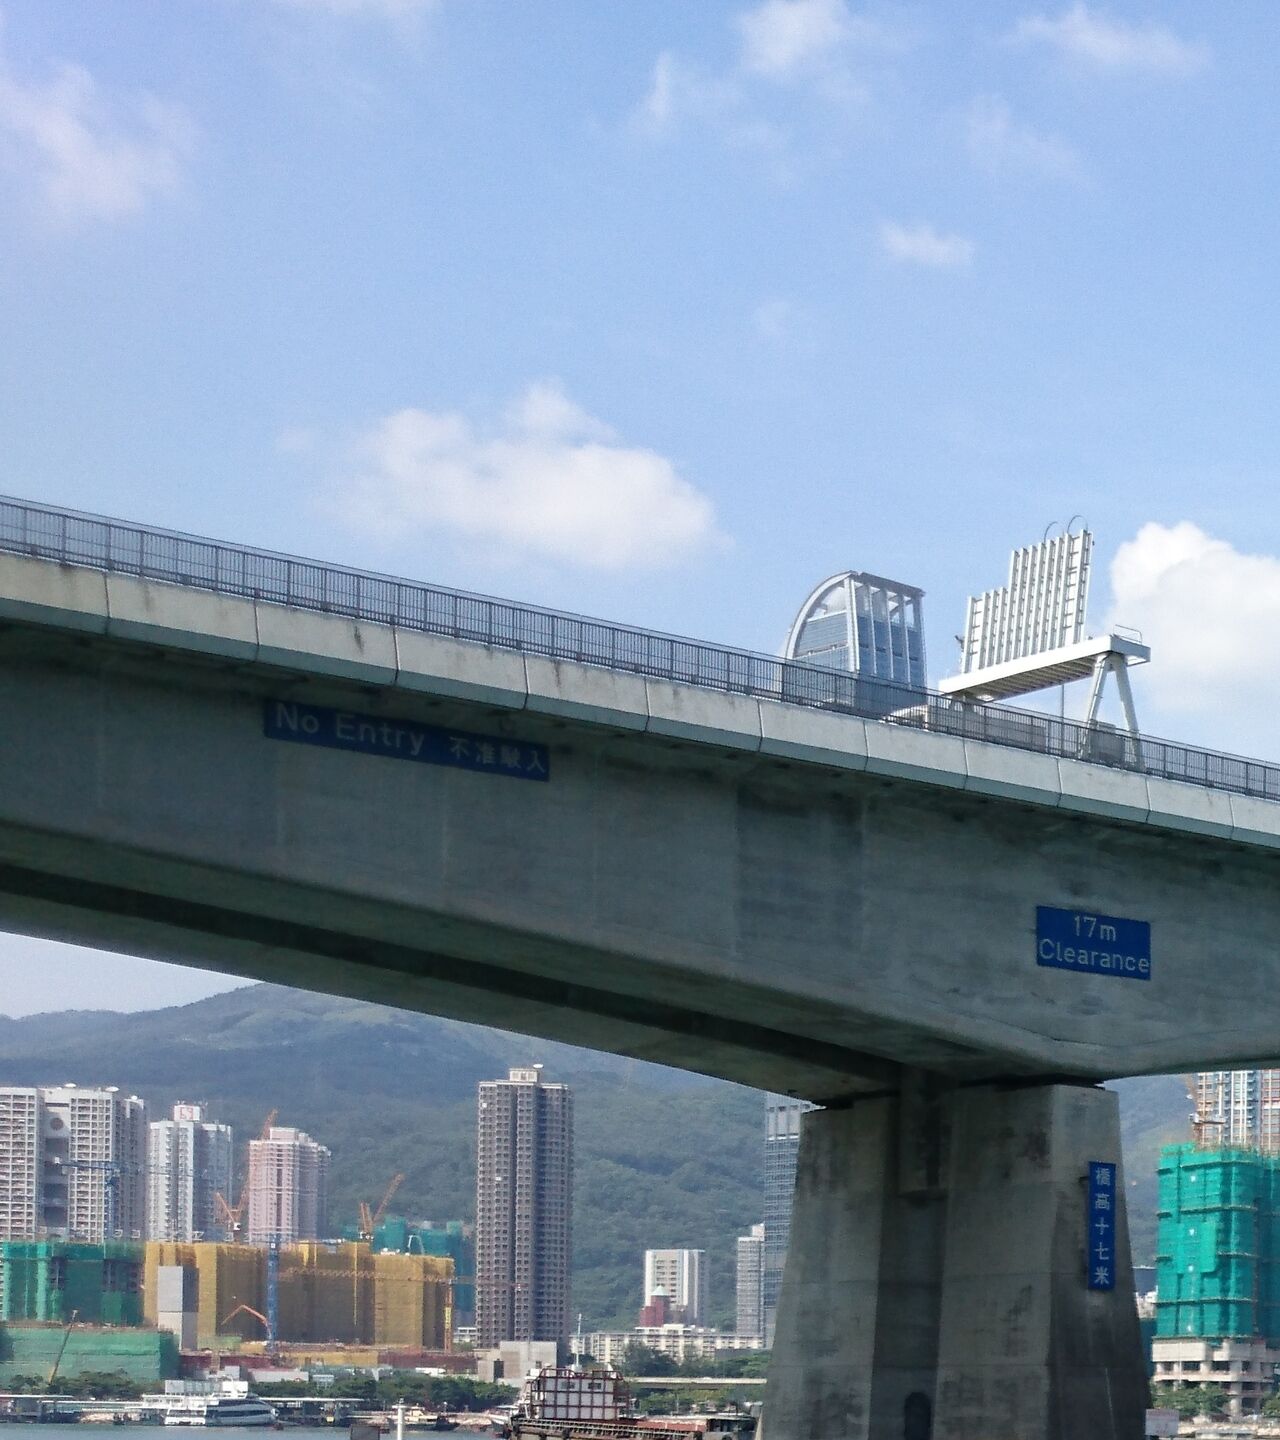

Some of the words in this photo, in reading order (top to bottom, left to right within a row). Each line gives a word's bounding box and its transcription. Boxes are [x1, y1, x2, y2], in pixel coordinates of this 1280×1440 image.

[275, 702, 320, 734] No
[335, 714, 425, 756] Entry
[1073, 915, 1117, 942] 17m
[1039, 938, 1151, 973] Clearance
[1094, 1167, 1111, 1286] 橋高十七米
